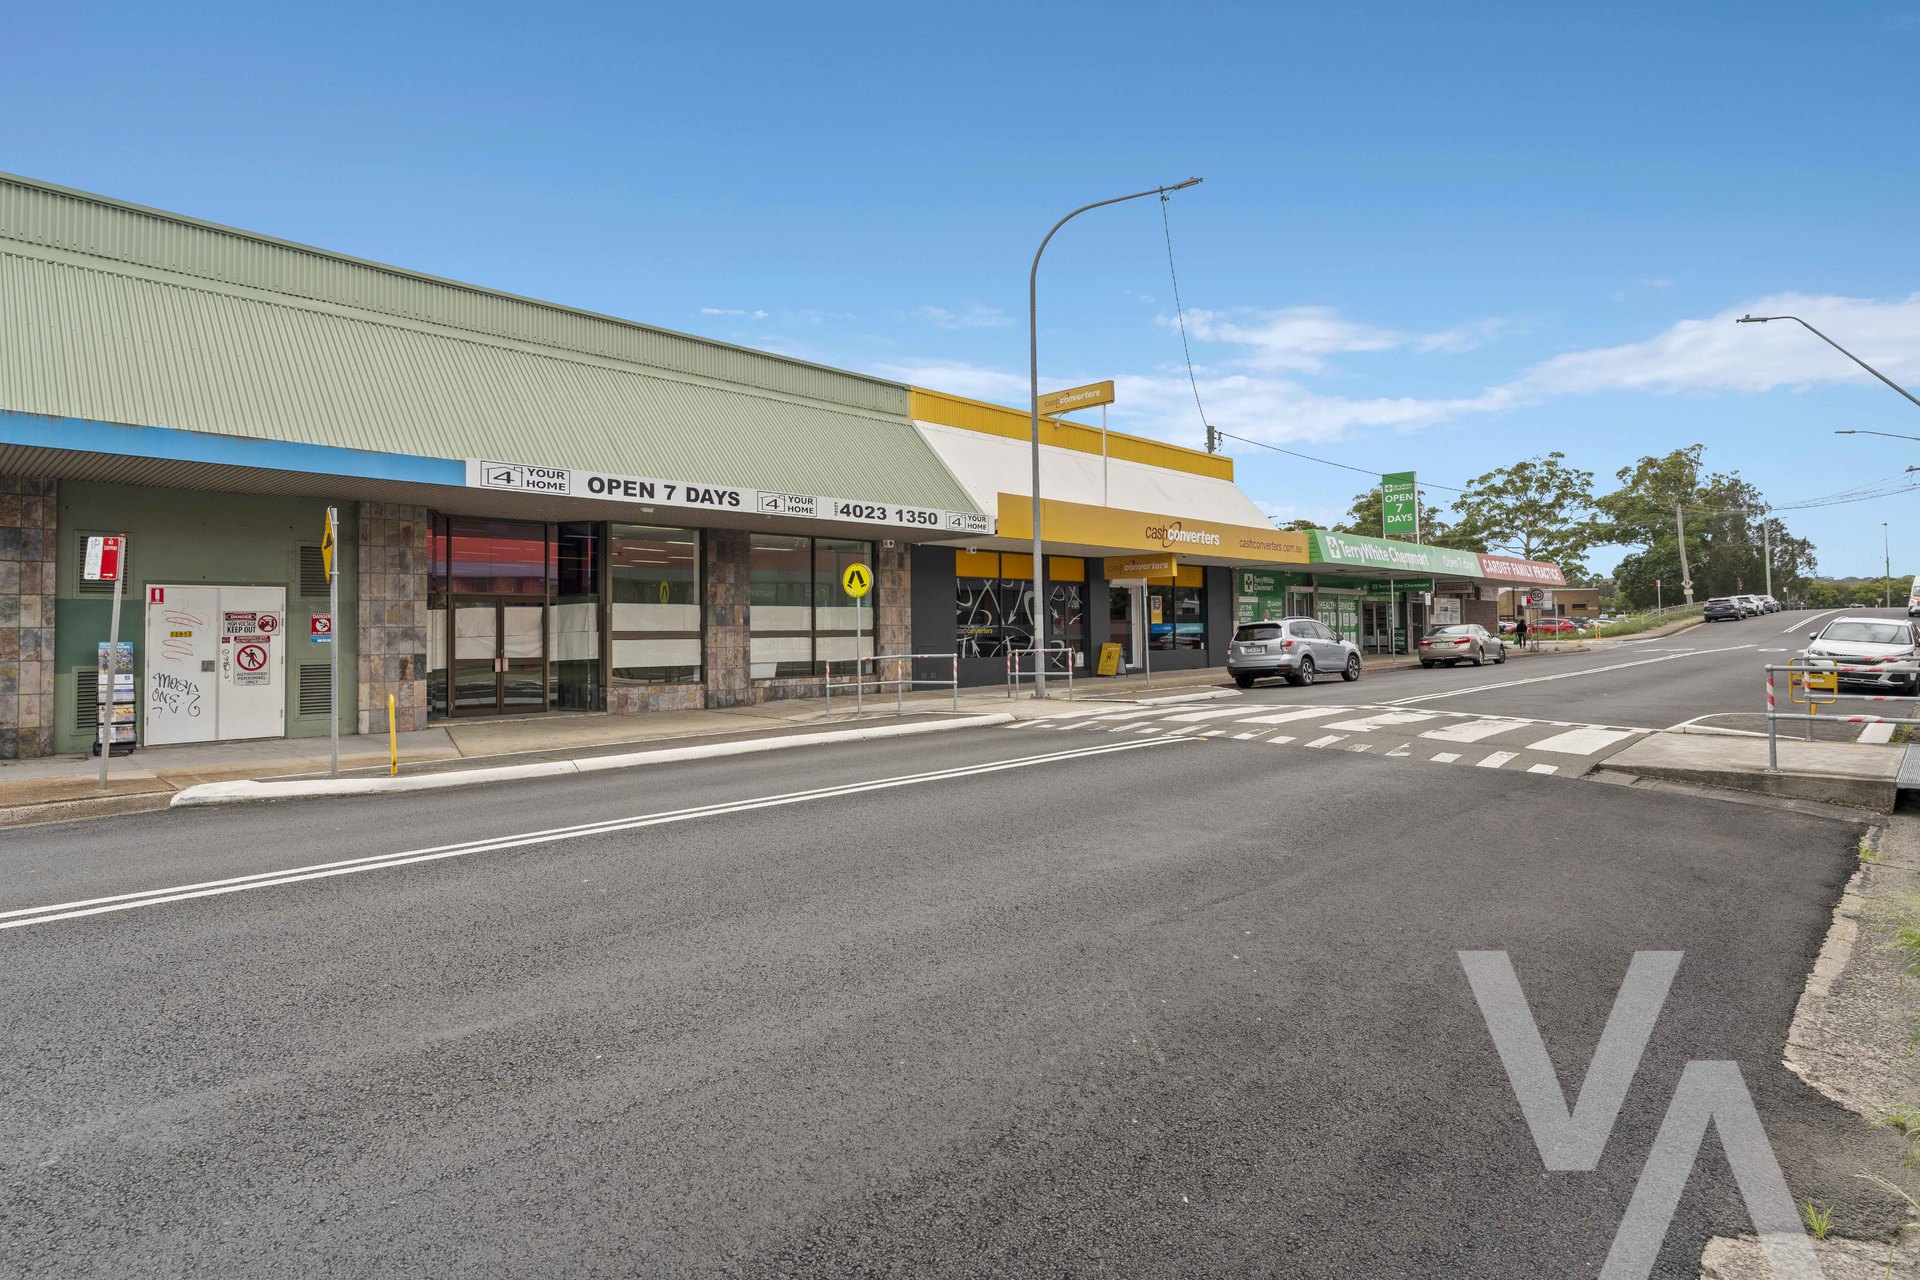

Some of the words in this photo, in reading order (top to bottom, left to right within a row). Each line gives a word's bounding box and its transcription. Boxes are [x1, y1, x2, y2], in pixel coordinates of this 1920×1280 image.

[493, 471, 515, 484] 4
[526, 468, 565, 480] YOUR
[526, 479, 566, 491] HOME
[587, 476, 655, 499] OPEN
[663, 485, 677, 500] 7
[686, 486, 740, 507] DAYS
[1385, 493, 1413, 502] OPEN
[765, 498, 780, 509] 4
[788, 496, 814, 505] YOUR
[1396, 503, 1403, 513] 7
[787, 505, 814, 514] HOME
[839, 503, 887, 520] 4023
[895, 510, 938, 525] 1350
[951, 517, 962, 527] 4
[967, 515, 987, 523] YOUR
[1387, 514, 1413, 523] DAYS
[967, 522, 987, 531] HOME
[1239, 538, 1302, 553] cashconverters.com.au
[1338, 540, 1389, 563] TerryWhite
[1388, 546, 1430, 567] Chemmart
[1442, 554, 1459, 569] Open
[1482, 559, 1512, 575] CARDIFF
[1510, 562, 1534, 577] FAMILY
[1532, 565, 1561, 580] PRACTICE
[1339, 602, 1355, 610] ERVICES
